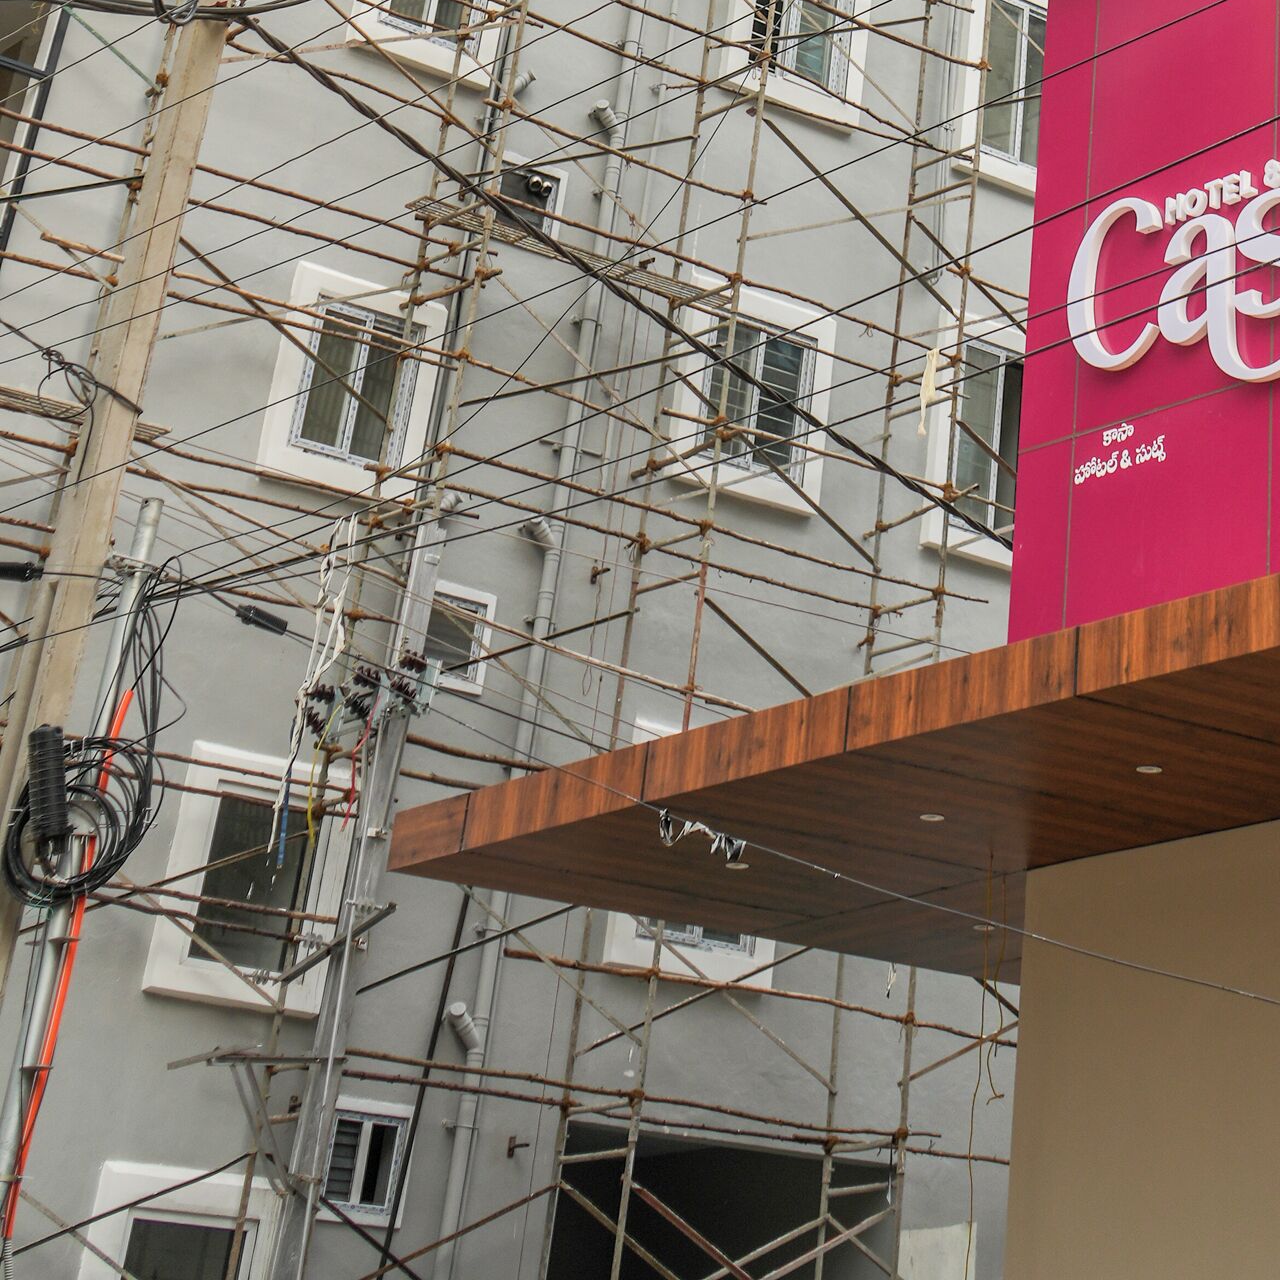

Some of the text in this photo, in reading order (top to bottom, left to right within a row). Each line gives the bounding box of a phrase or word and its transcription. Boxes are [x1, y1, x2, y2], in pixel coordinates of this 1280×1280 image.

[1164, 170, 1258, 226] HOTEL
[1103, 423, 1134, 446] కాసా
[1074, 451, 1119, 485] హోటల్
[1119, 449, 1132, 469] &
